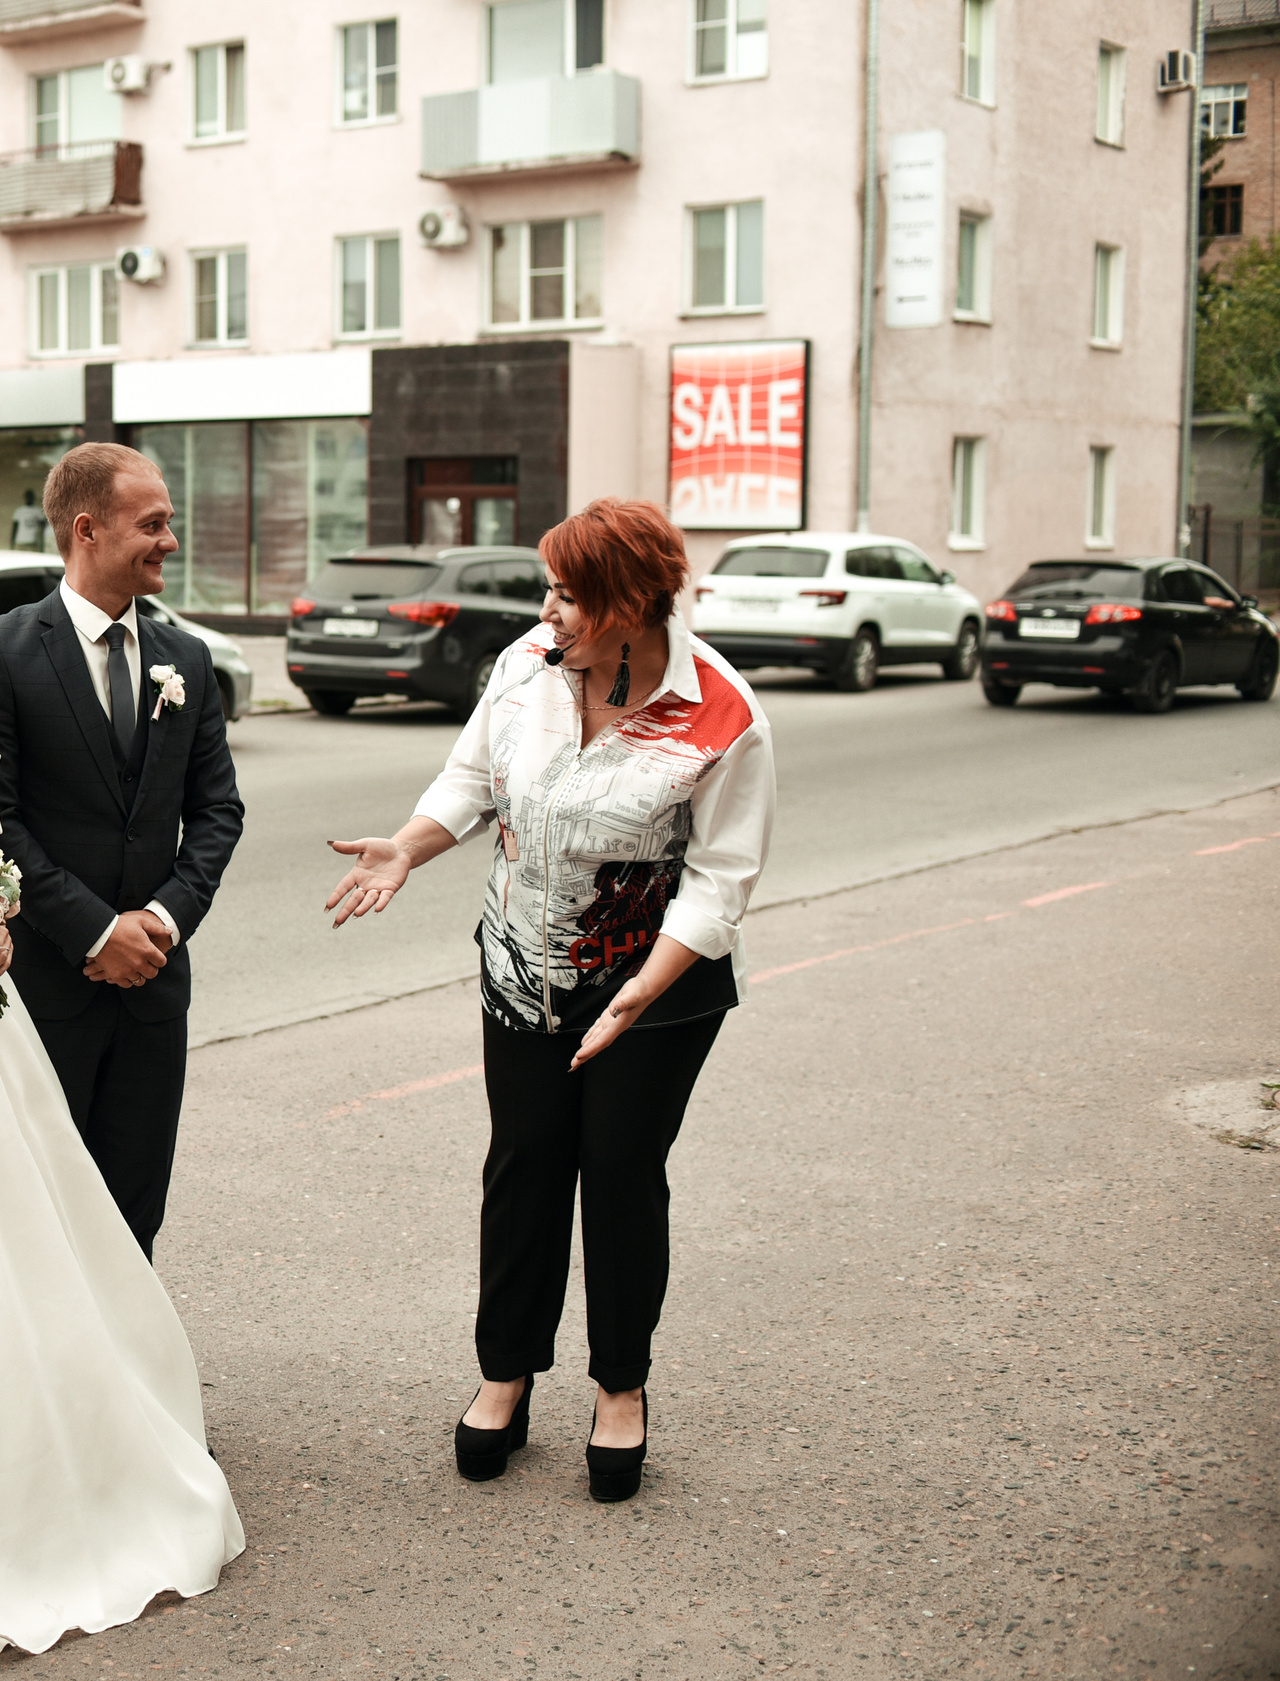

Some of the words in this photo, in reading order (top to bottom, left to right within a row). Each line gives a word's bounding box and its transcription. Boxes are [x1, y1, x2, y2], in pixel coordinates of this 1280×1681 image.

[672, 378, 801, 451] SALE
[614, 801, 649, 819] beauty
[587, 835, 637, 855] Life
[595, 867, 643, 918] Stay
[568, 928, 660, 970] CHI
